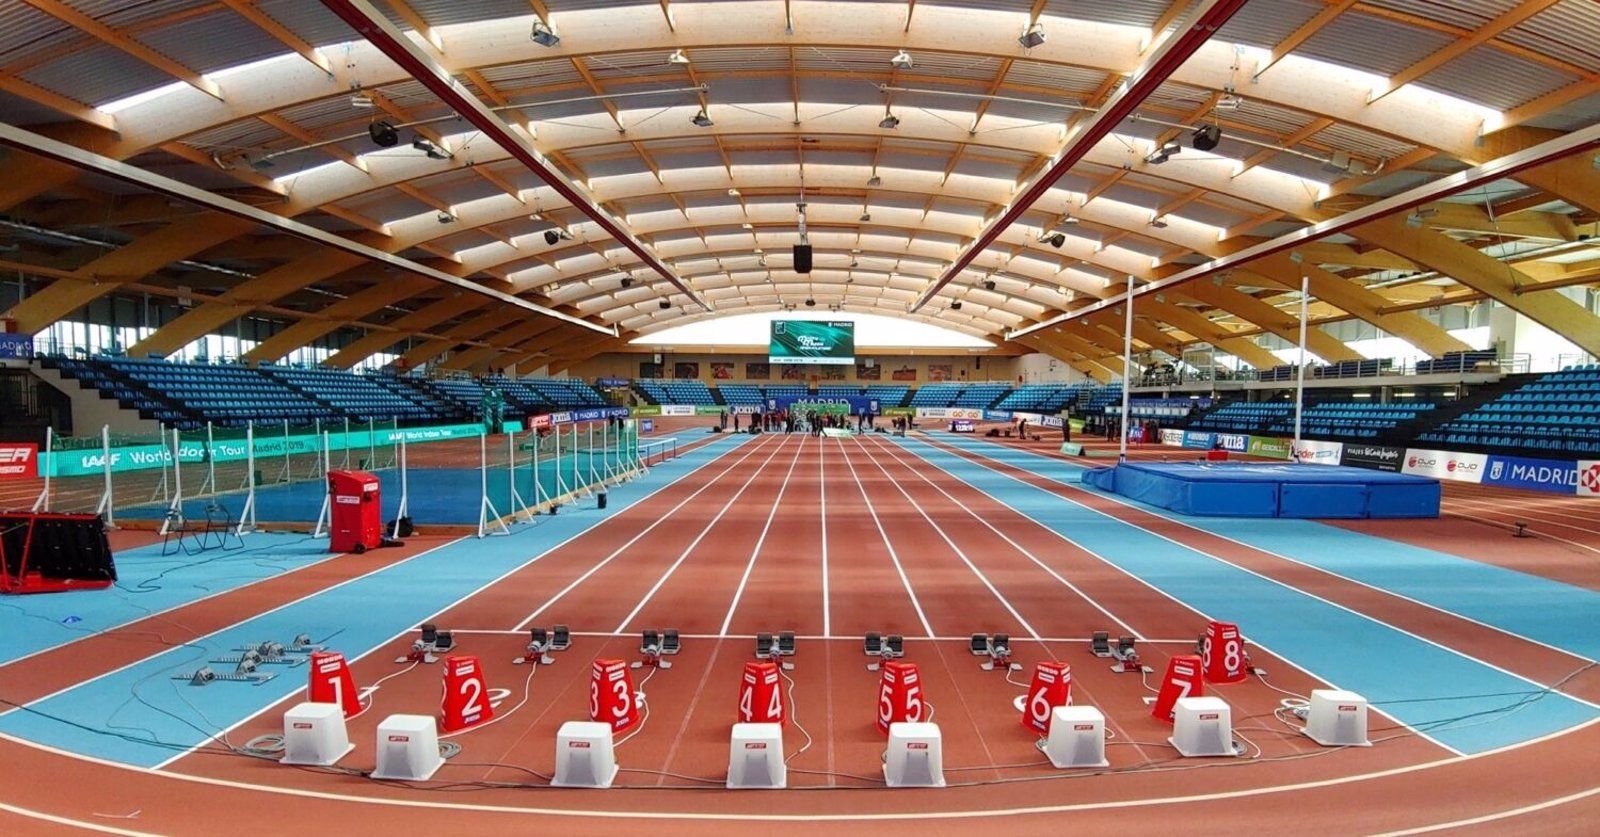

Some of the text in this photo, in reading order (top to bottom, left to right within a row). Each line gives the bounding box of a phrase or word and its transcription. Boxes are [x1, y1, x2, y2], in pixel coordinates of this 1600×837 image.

[130, 449, 172, 464] World
[219, 445, 245, 456] Tour
[1511, 464, 1577, 486] MADRID
[1203, 637, 1212, 668] 8
[1224, 640, 1239, 671] 8
[461, 678, 482, 716] 2
[590, 681, 599, 717] 3
[612, 680, 630, 717] 3
[740, 686, 753, 721] 4
[767, 683, 782, 719] 4
[880, 684, 893, 722] 5
[905, 686, 921, 723] 5
[1031, 687, 1051, 722] 6
[1171, 678, 1192, 712] 7
